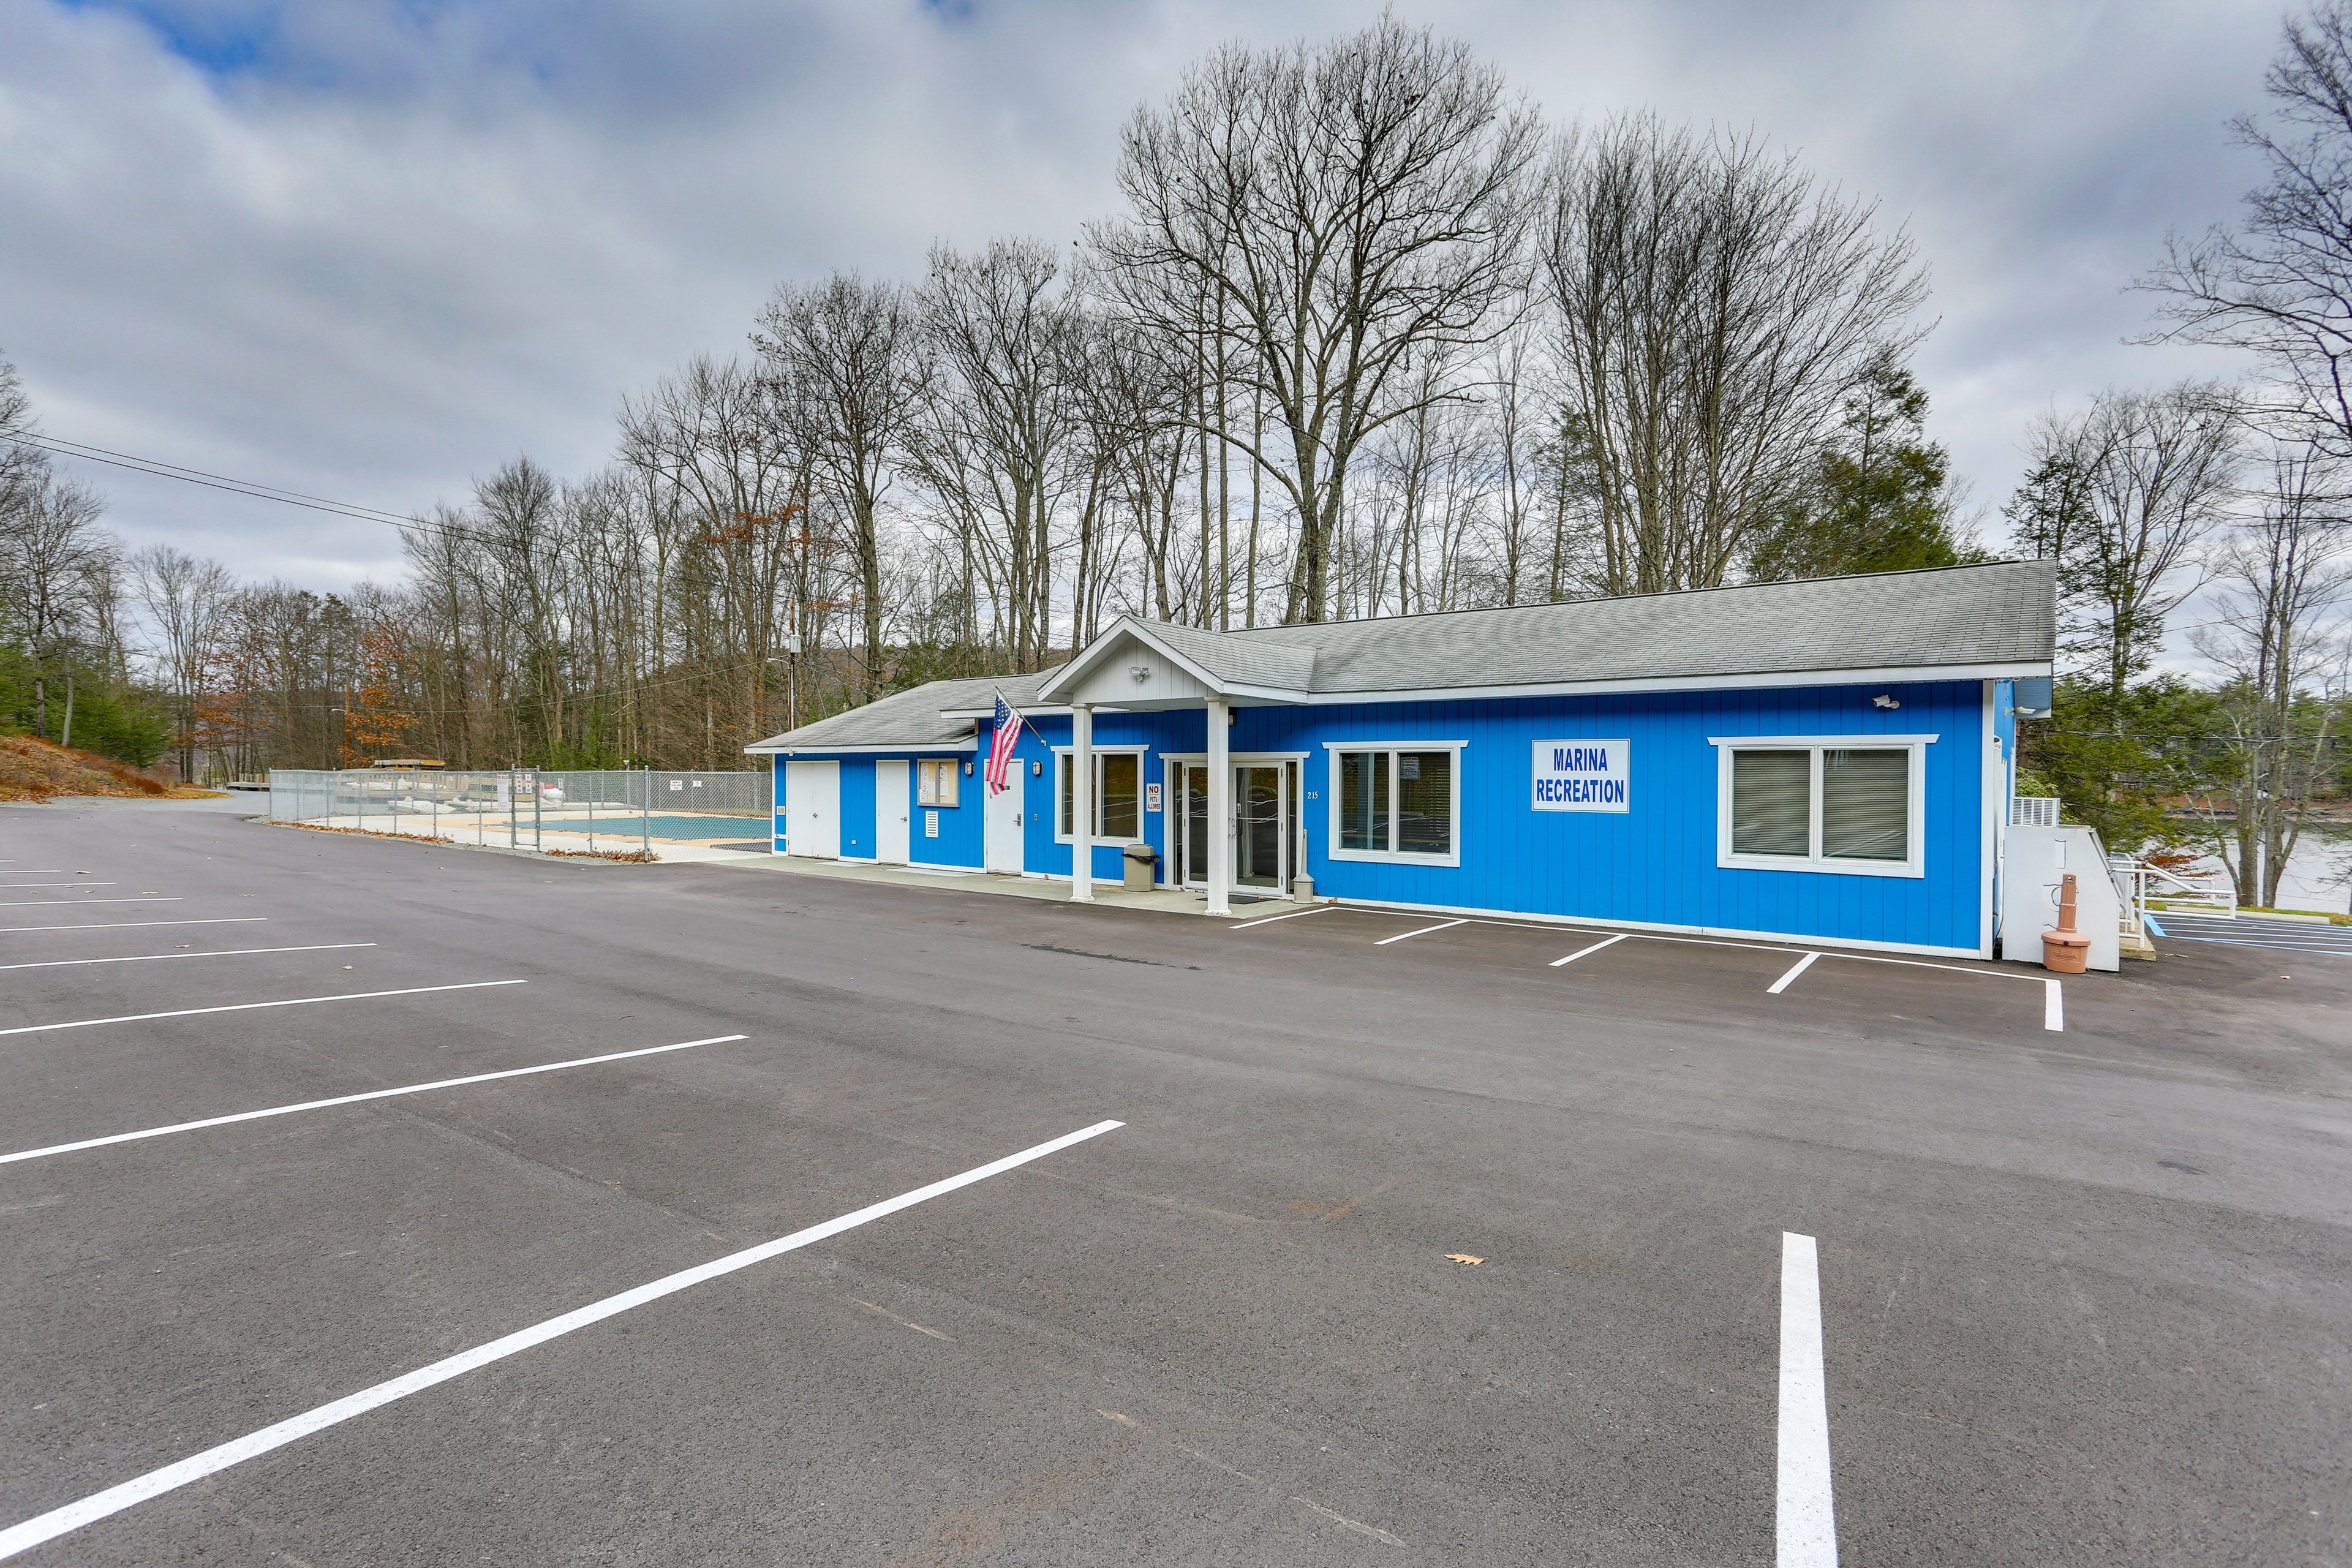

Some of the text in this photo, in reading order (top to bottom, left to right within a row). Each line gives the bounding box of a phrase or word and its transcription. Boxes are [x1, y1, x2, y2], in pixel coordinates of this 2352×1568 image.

[1553, 748, 1608, 771] MARINA
[1307, 791, 1318, 799] 215
[1536, 779, 1624, 803] RECREATION
